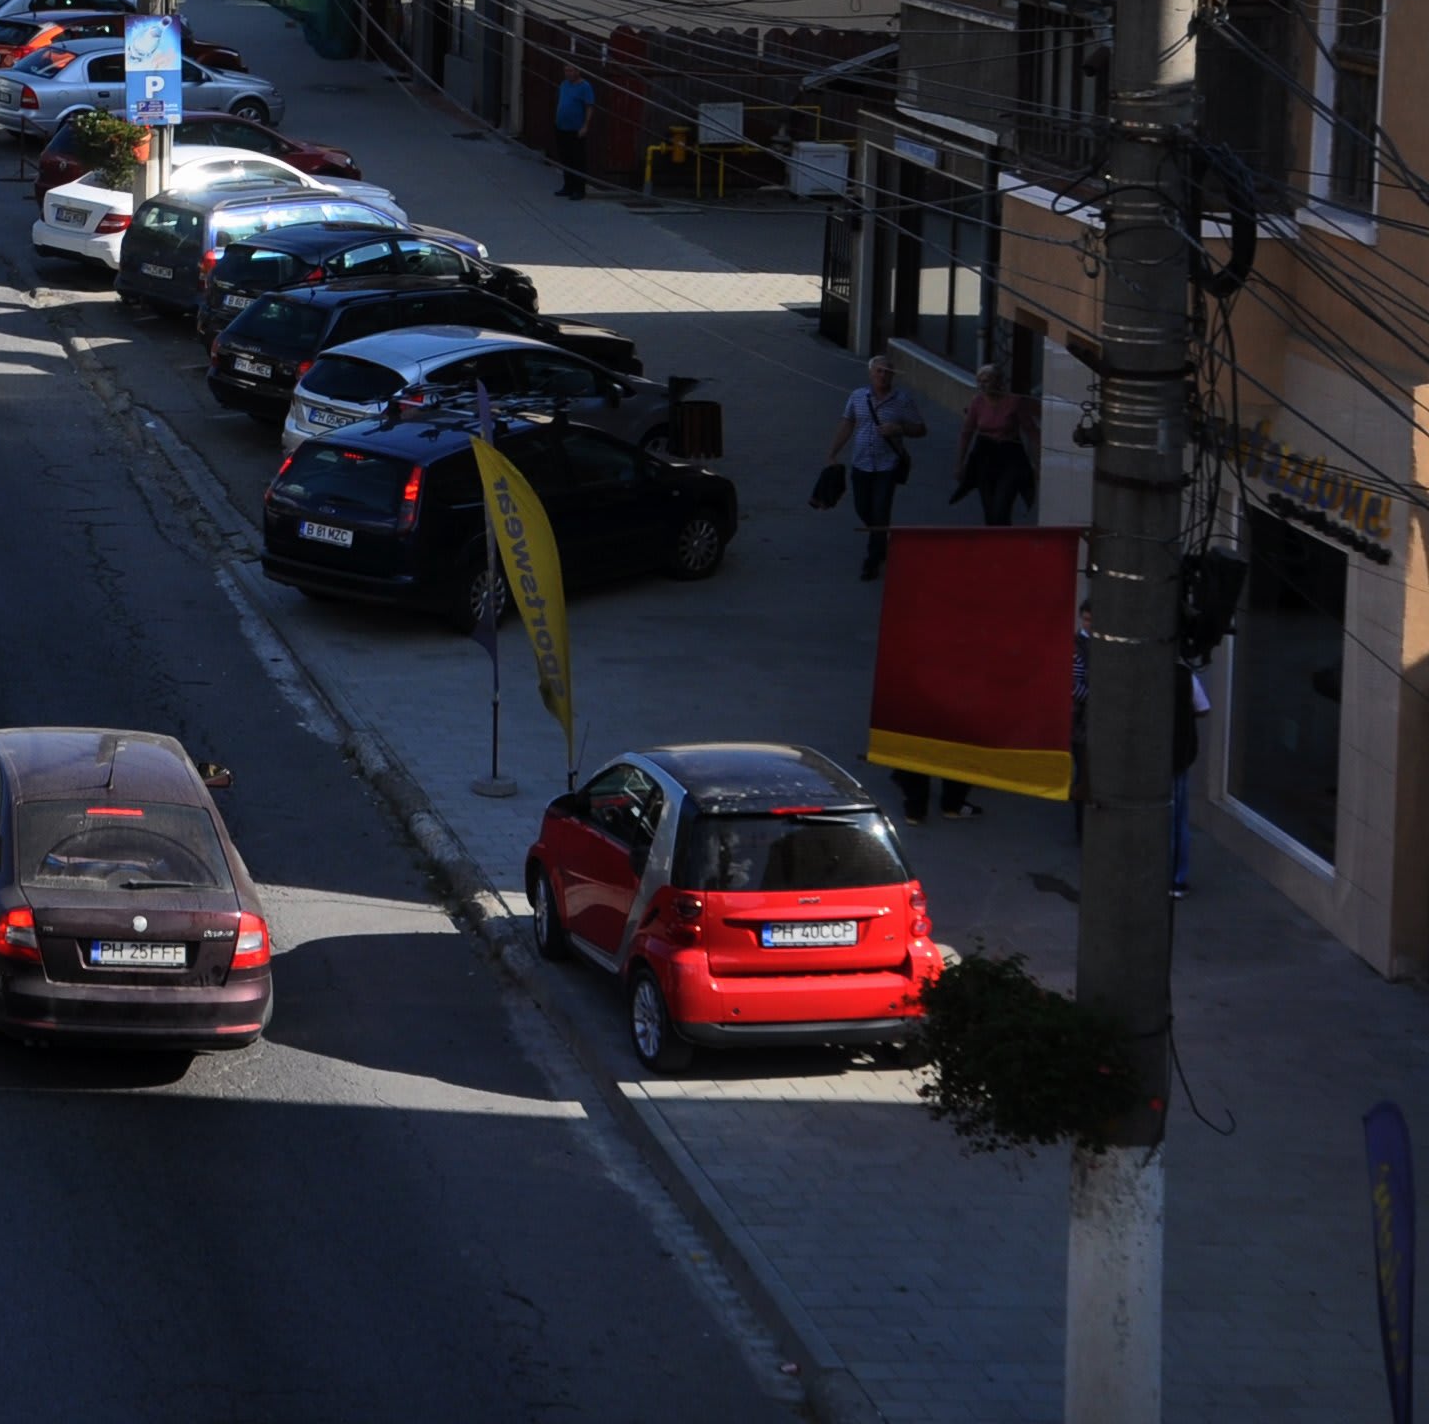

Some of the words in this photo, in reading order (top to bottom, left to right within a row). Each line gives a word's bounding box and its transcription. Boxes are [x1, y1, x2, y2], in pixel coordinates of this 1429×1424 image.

[145, 75, 165, 99] P
[771, 924, 794, 940] PH
[800, 923, 854, 939] 40CCP
[100, 942, 124, 959] PH
[130, 943, 185, 960] 25FFF
